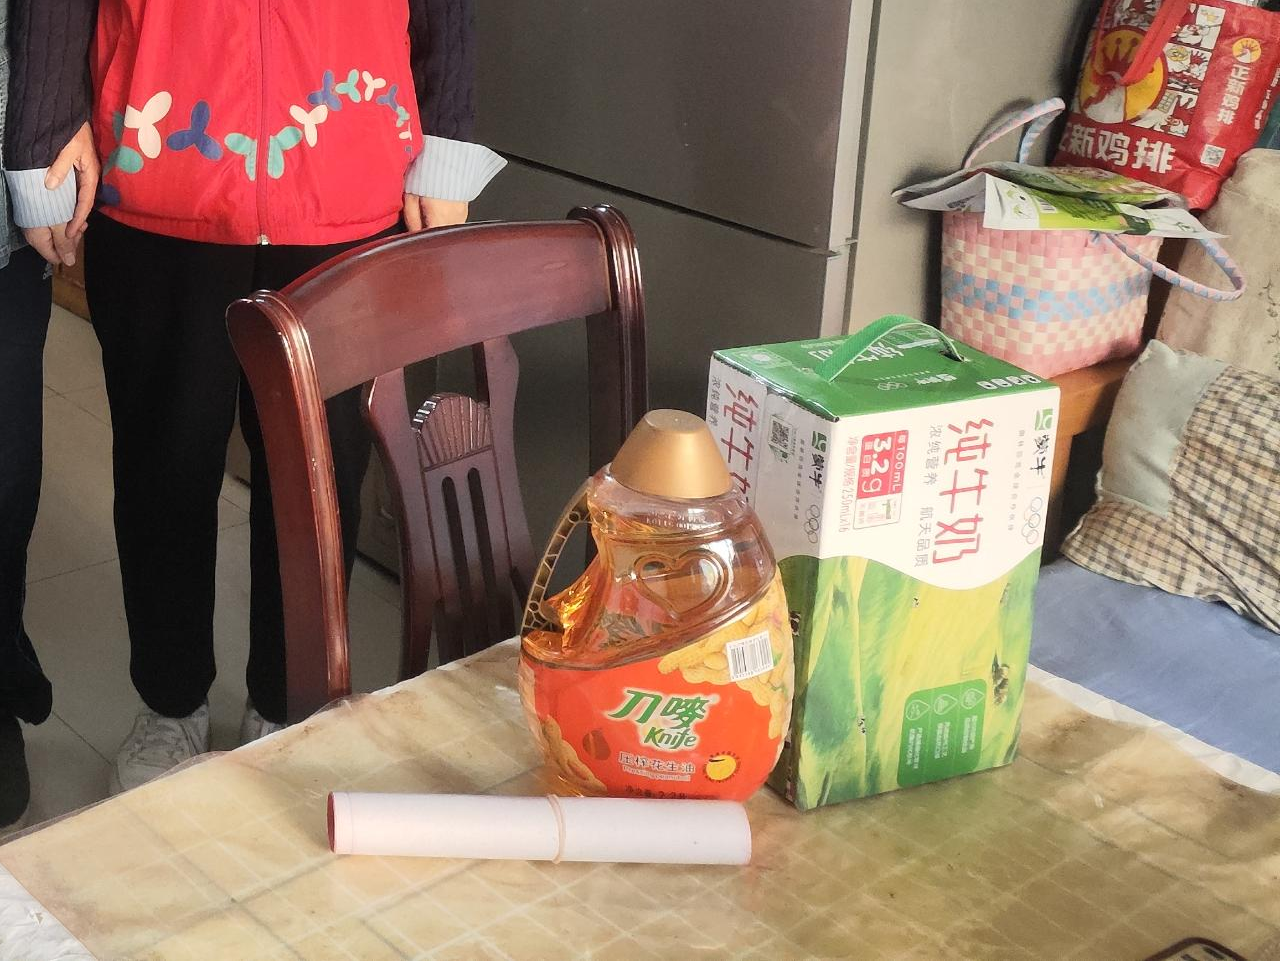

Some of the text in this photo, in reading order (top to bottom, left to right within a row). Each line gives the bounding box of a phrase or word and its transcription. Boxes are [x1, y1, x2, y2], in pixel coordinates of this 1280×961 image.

[1217, 64, 1250, 125] 正新鸡排
[808, 453, 825, 488] 蒙牛
[861, 436, 892, 493] 3.2g
[1029, 434, 1050, 476] 蒙牛
[914, 424, 943, 568] 浓纯营养 航天品质
[932, 418, 994, 564] 纯牛奶
[644, 727, 697, 749] Knife
